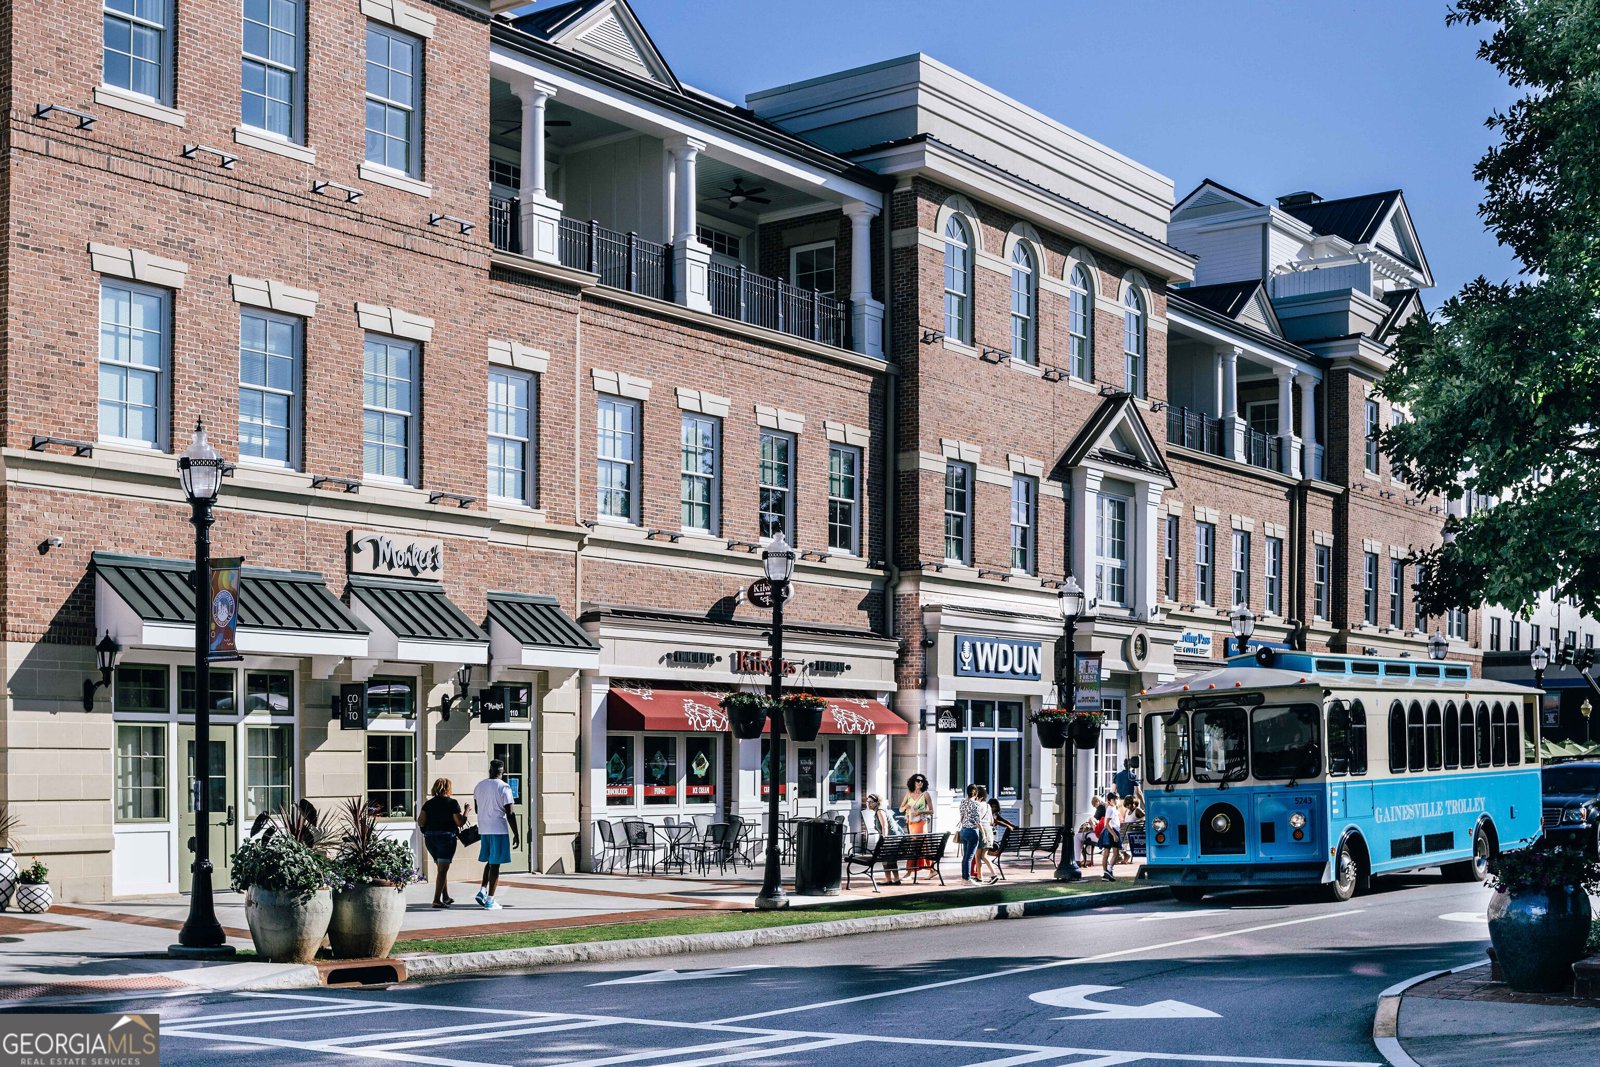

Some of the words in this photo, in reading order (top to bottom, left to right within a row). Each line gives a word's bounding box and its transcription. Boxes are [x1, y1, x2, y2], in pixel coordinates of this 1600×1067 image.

[753, 583, 772, 593] Kilw
[736, 650, 796, 675] Kilwns
[976, 641, 1041, 675] WDUN
[347, 694, 359, 703] CO
[347, 711, 359, 720] TO
[510, 709, 519, 717] 110
[1375, 801, 1444, 824] GAINESVILLE
[1445, 797, 1485, 815] TROLLEY
